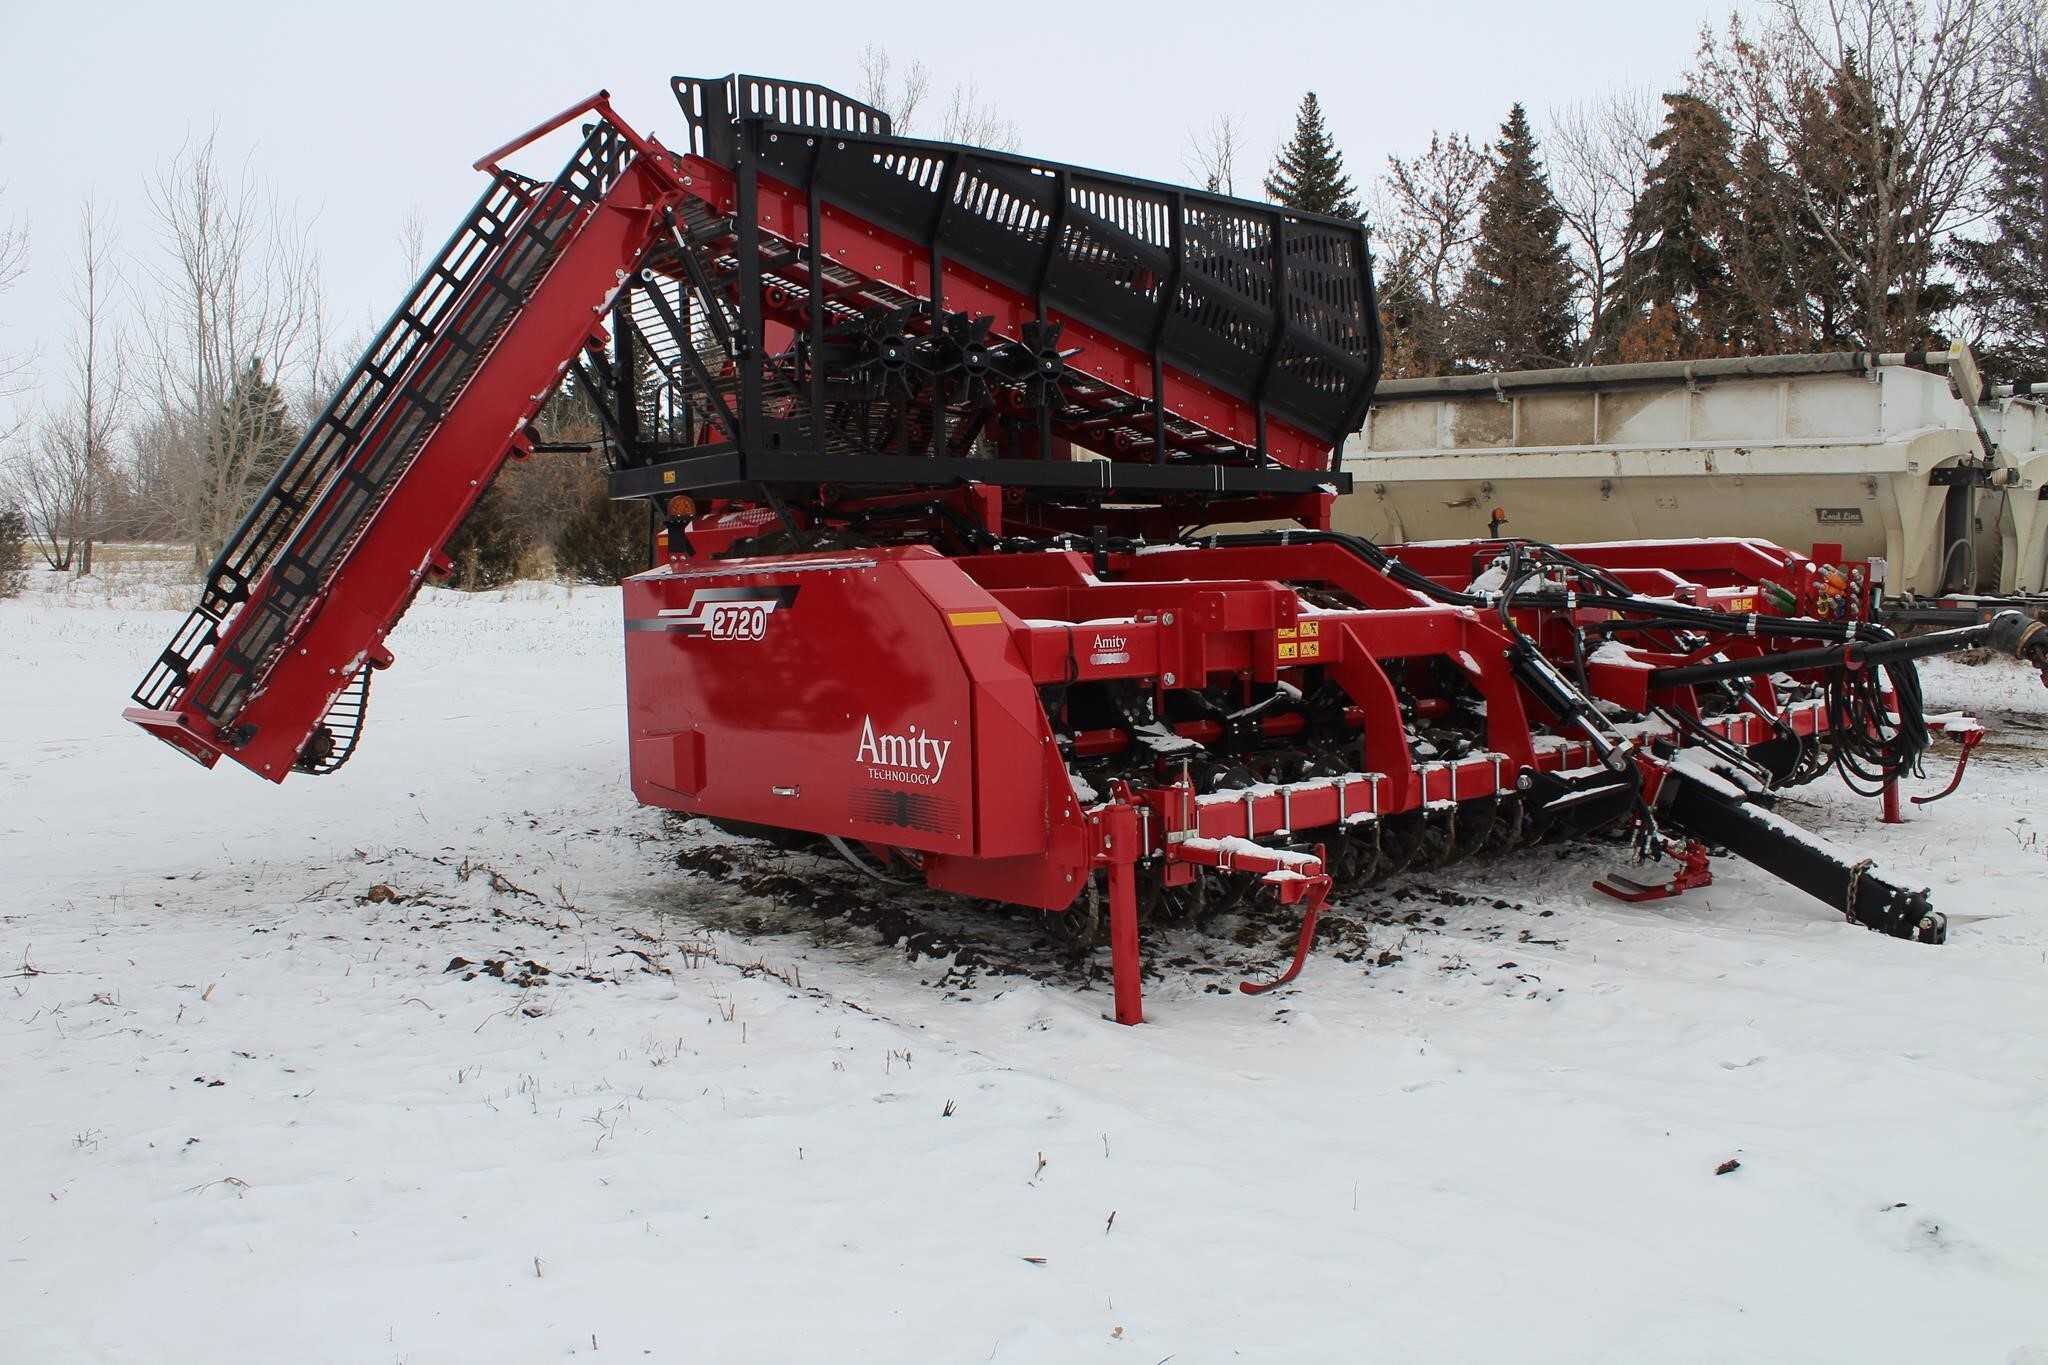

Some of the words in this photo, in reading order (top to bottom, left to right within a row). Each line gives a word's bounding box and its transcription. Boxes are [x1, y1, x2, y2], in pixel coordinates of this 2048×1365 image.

[713, 608, 765, 637] 2720
[1093, 633, 1127, 651] Amity
[856, 713, 951, 784] Amity
[868, 768, 930, 785] TECHNOLOGY
